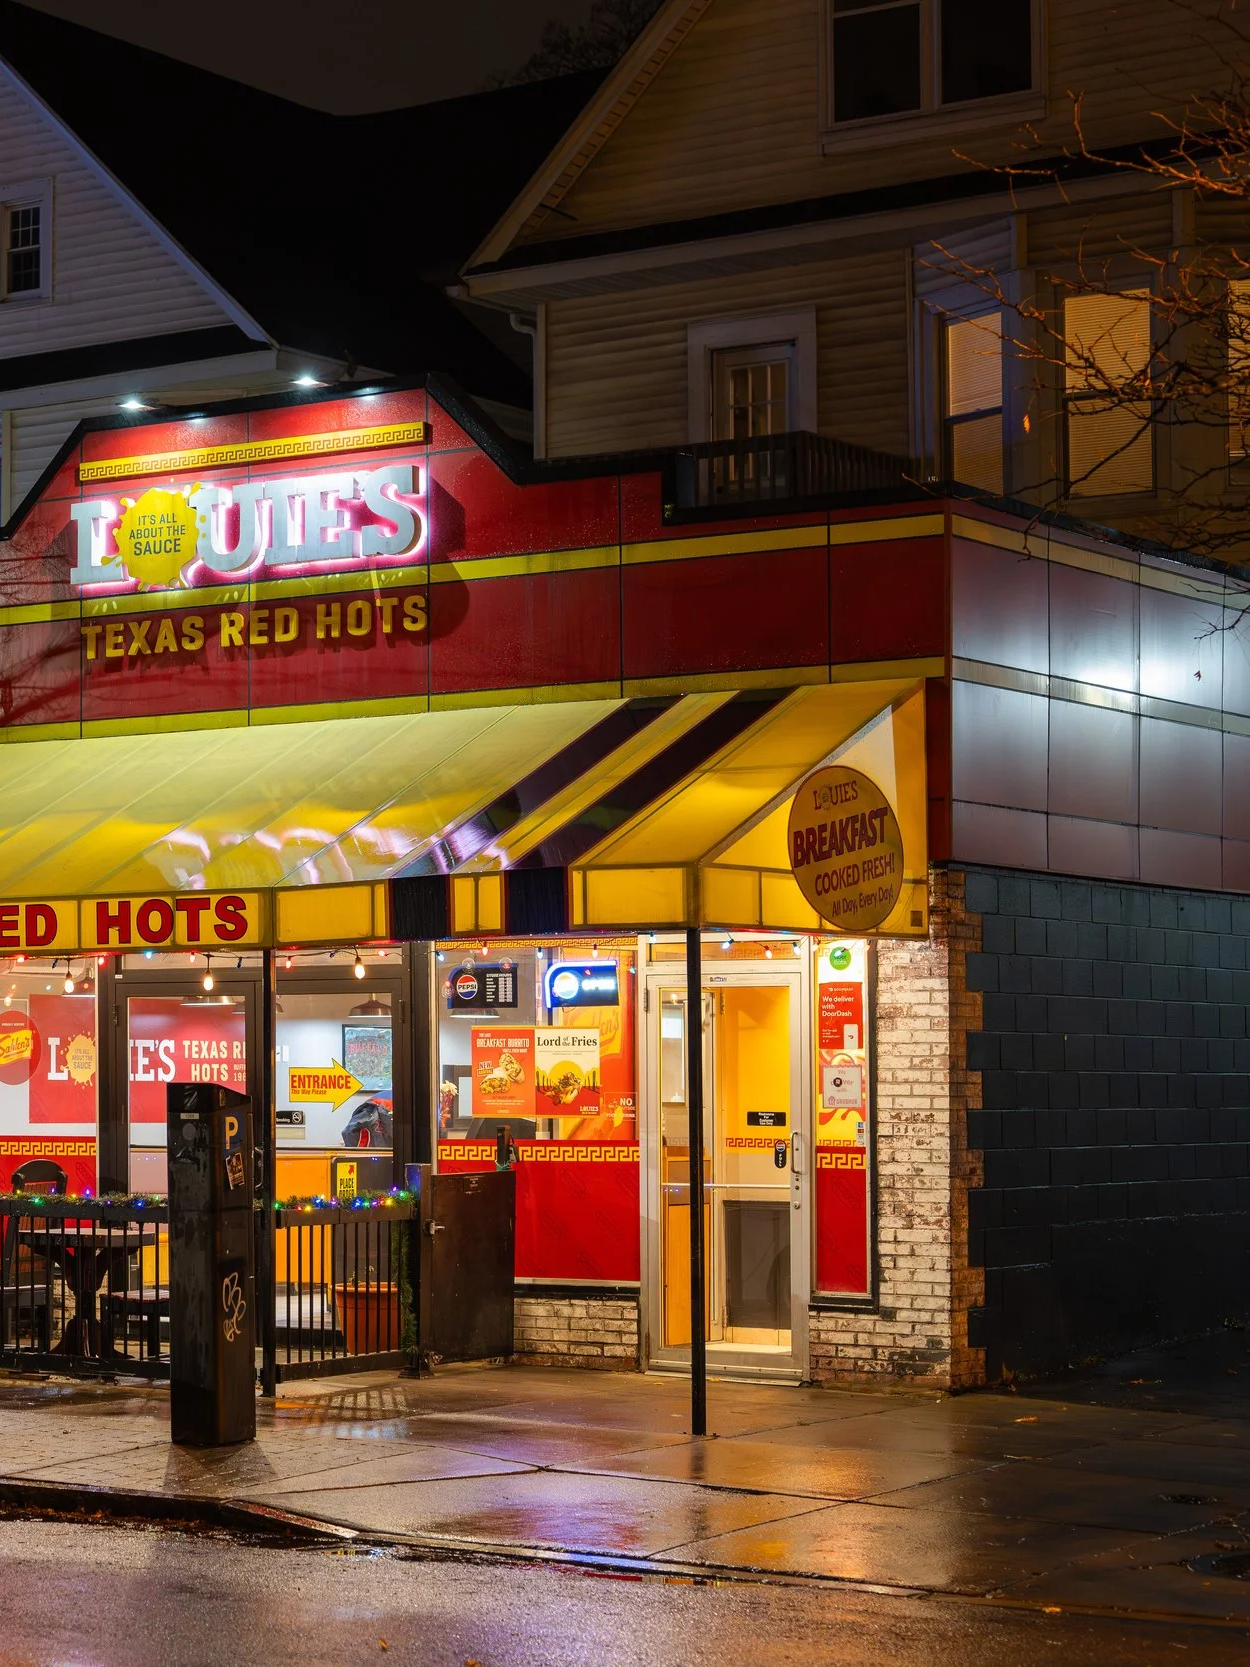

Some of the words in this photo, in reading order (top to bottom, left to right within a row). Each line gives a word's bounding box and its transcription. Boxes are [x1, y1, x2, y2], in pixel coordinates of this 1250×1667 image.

[137, 514, 157, 526] IT'S
[159, 512, 178, 524] ALL
[129, 526, 164, 540] ABOUT
[166, 524, 186, 537] THE
[133, 537, 181, 556] SAUCE
[81, 614, 206, 661] TEXAS
[220, 606, 300, 649] RED
[315, 594, 429, 640] HOTS
[793, 806, 889, 869] BREAKFAST
[814, 863, 860, 897] COOKED
[862, 851, 896, 883] FRESH!
[832, 900, 842, 918] All
[858, 890, 878, 909] Every
[878, 883, 894, 903] Day!
[96, 895, 249, 946] HOTS
[183, 1040, 228, 1059] TEXAS
[476, 1038, 507, 1048] BREAKFAST
[508, 1038, 530, 1048] BURRITO
[537, 1036, 561, 1046] Lord
[572, 1036, 598, 1046] Fries
[73, 1062, 92, 1070] SAUCE
[191, 1063, 229, 1082] HOTS
[290, 1074, 352, 1089] ENTRANCE
[225, 1115, 239, 1150] P
[340, 1178, 354, 1188] PLACE
